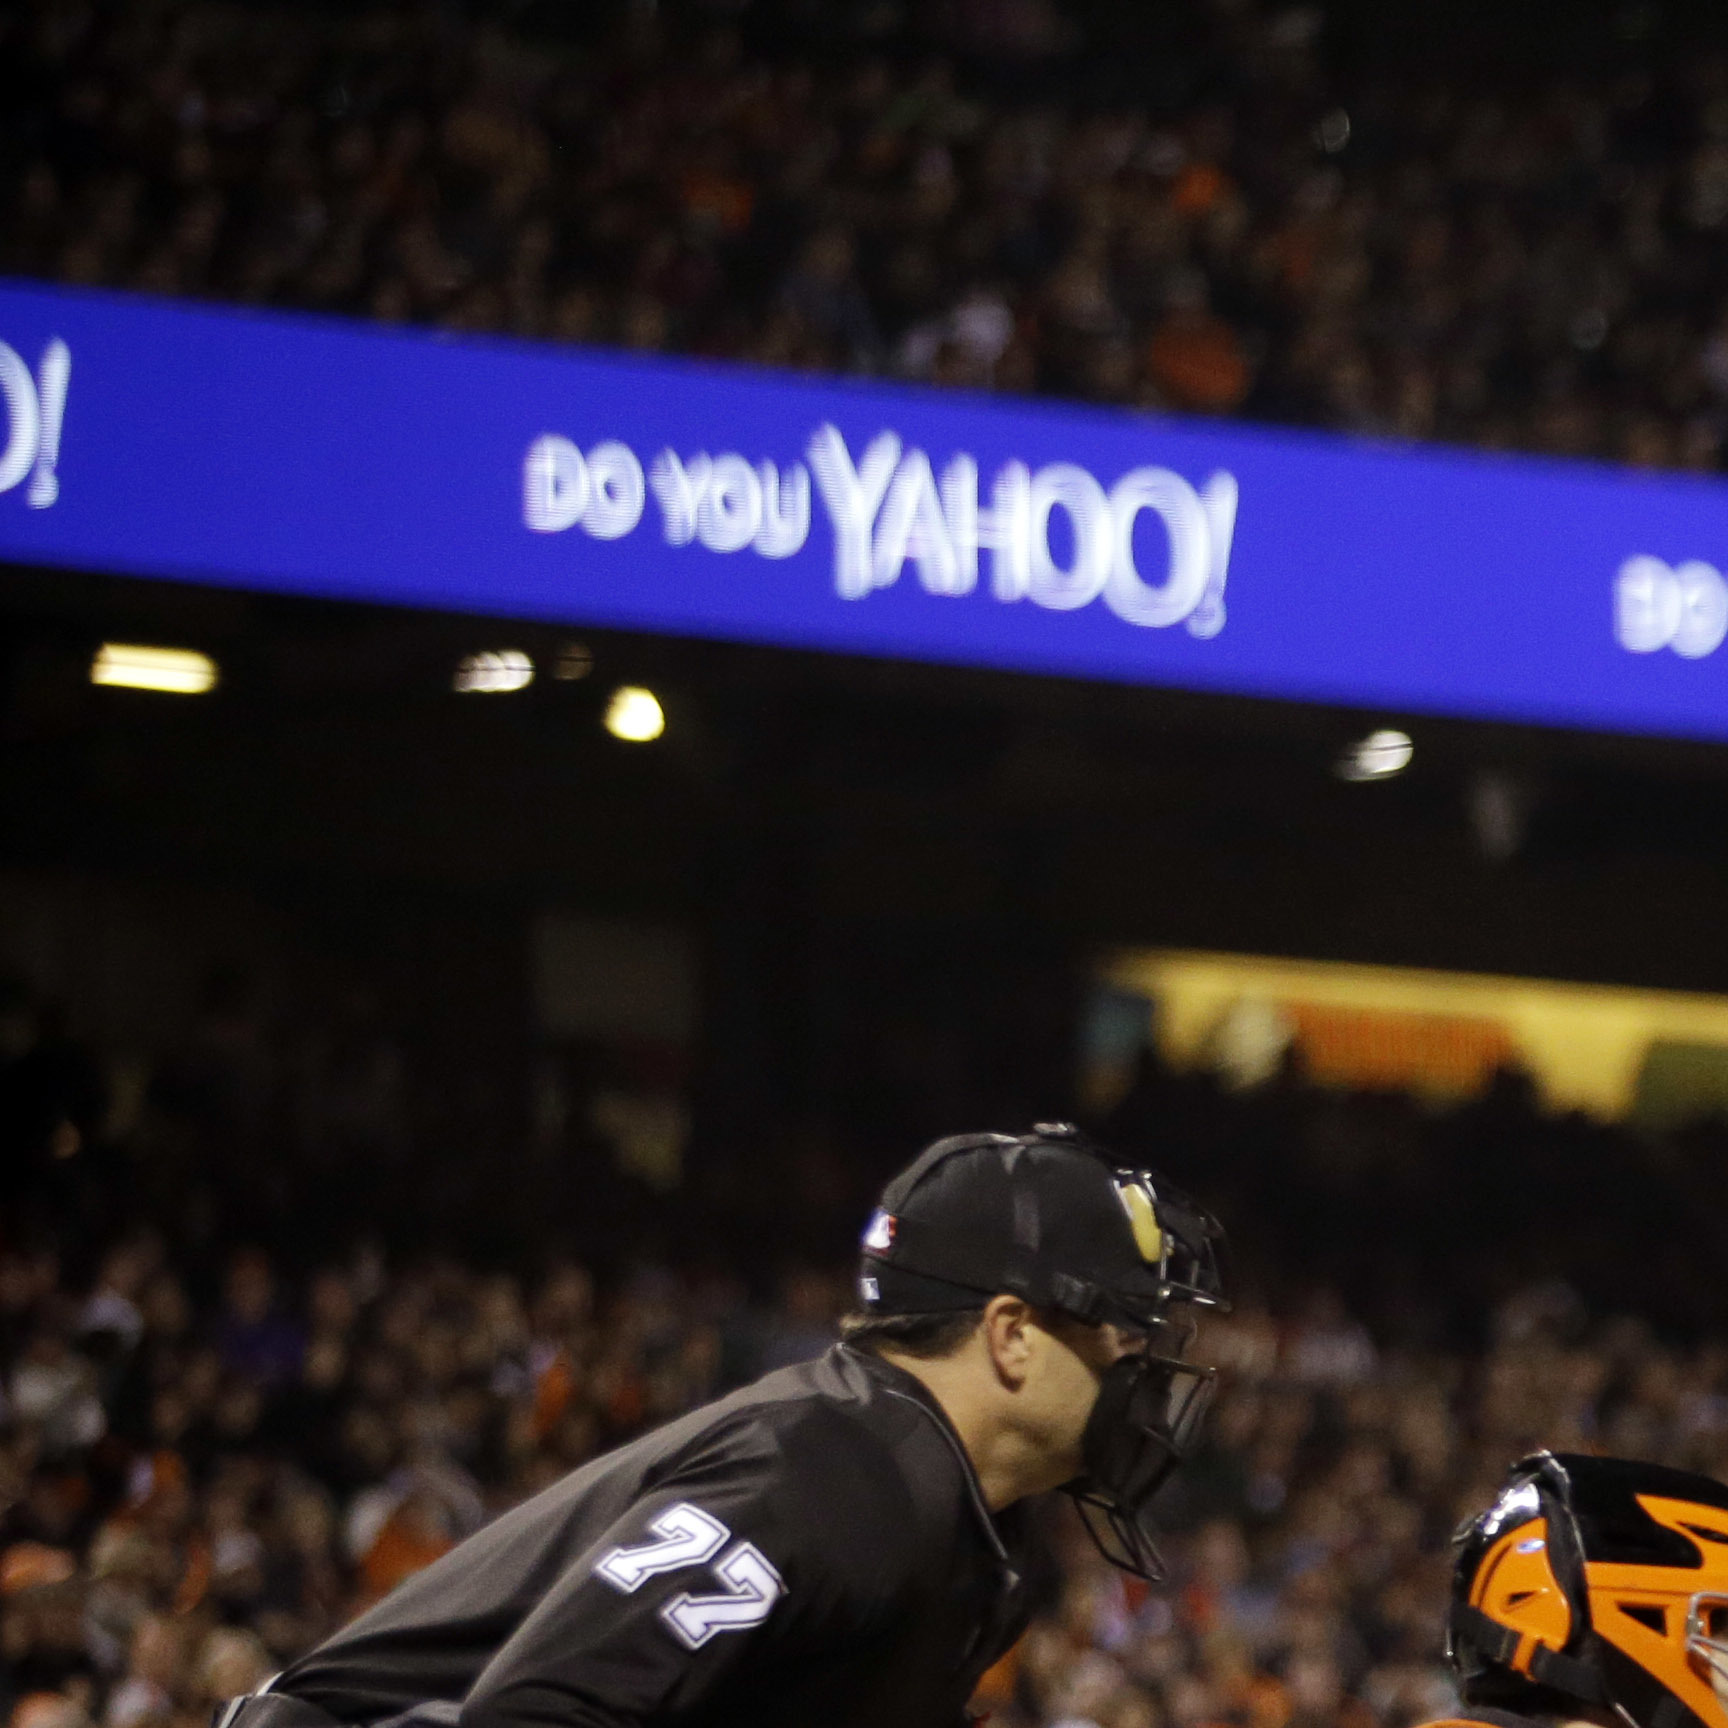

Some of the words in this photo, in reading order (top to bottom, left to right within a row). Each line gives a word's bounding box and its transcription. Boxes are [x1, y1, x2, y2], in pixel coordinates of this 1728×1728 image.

[522, 433, 646, 541] DO
[650, 446, 811, 560] YOU
[806, 422, 1239, 640] YAHOO!
[595, 1502, 790, 1650] 77
